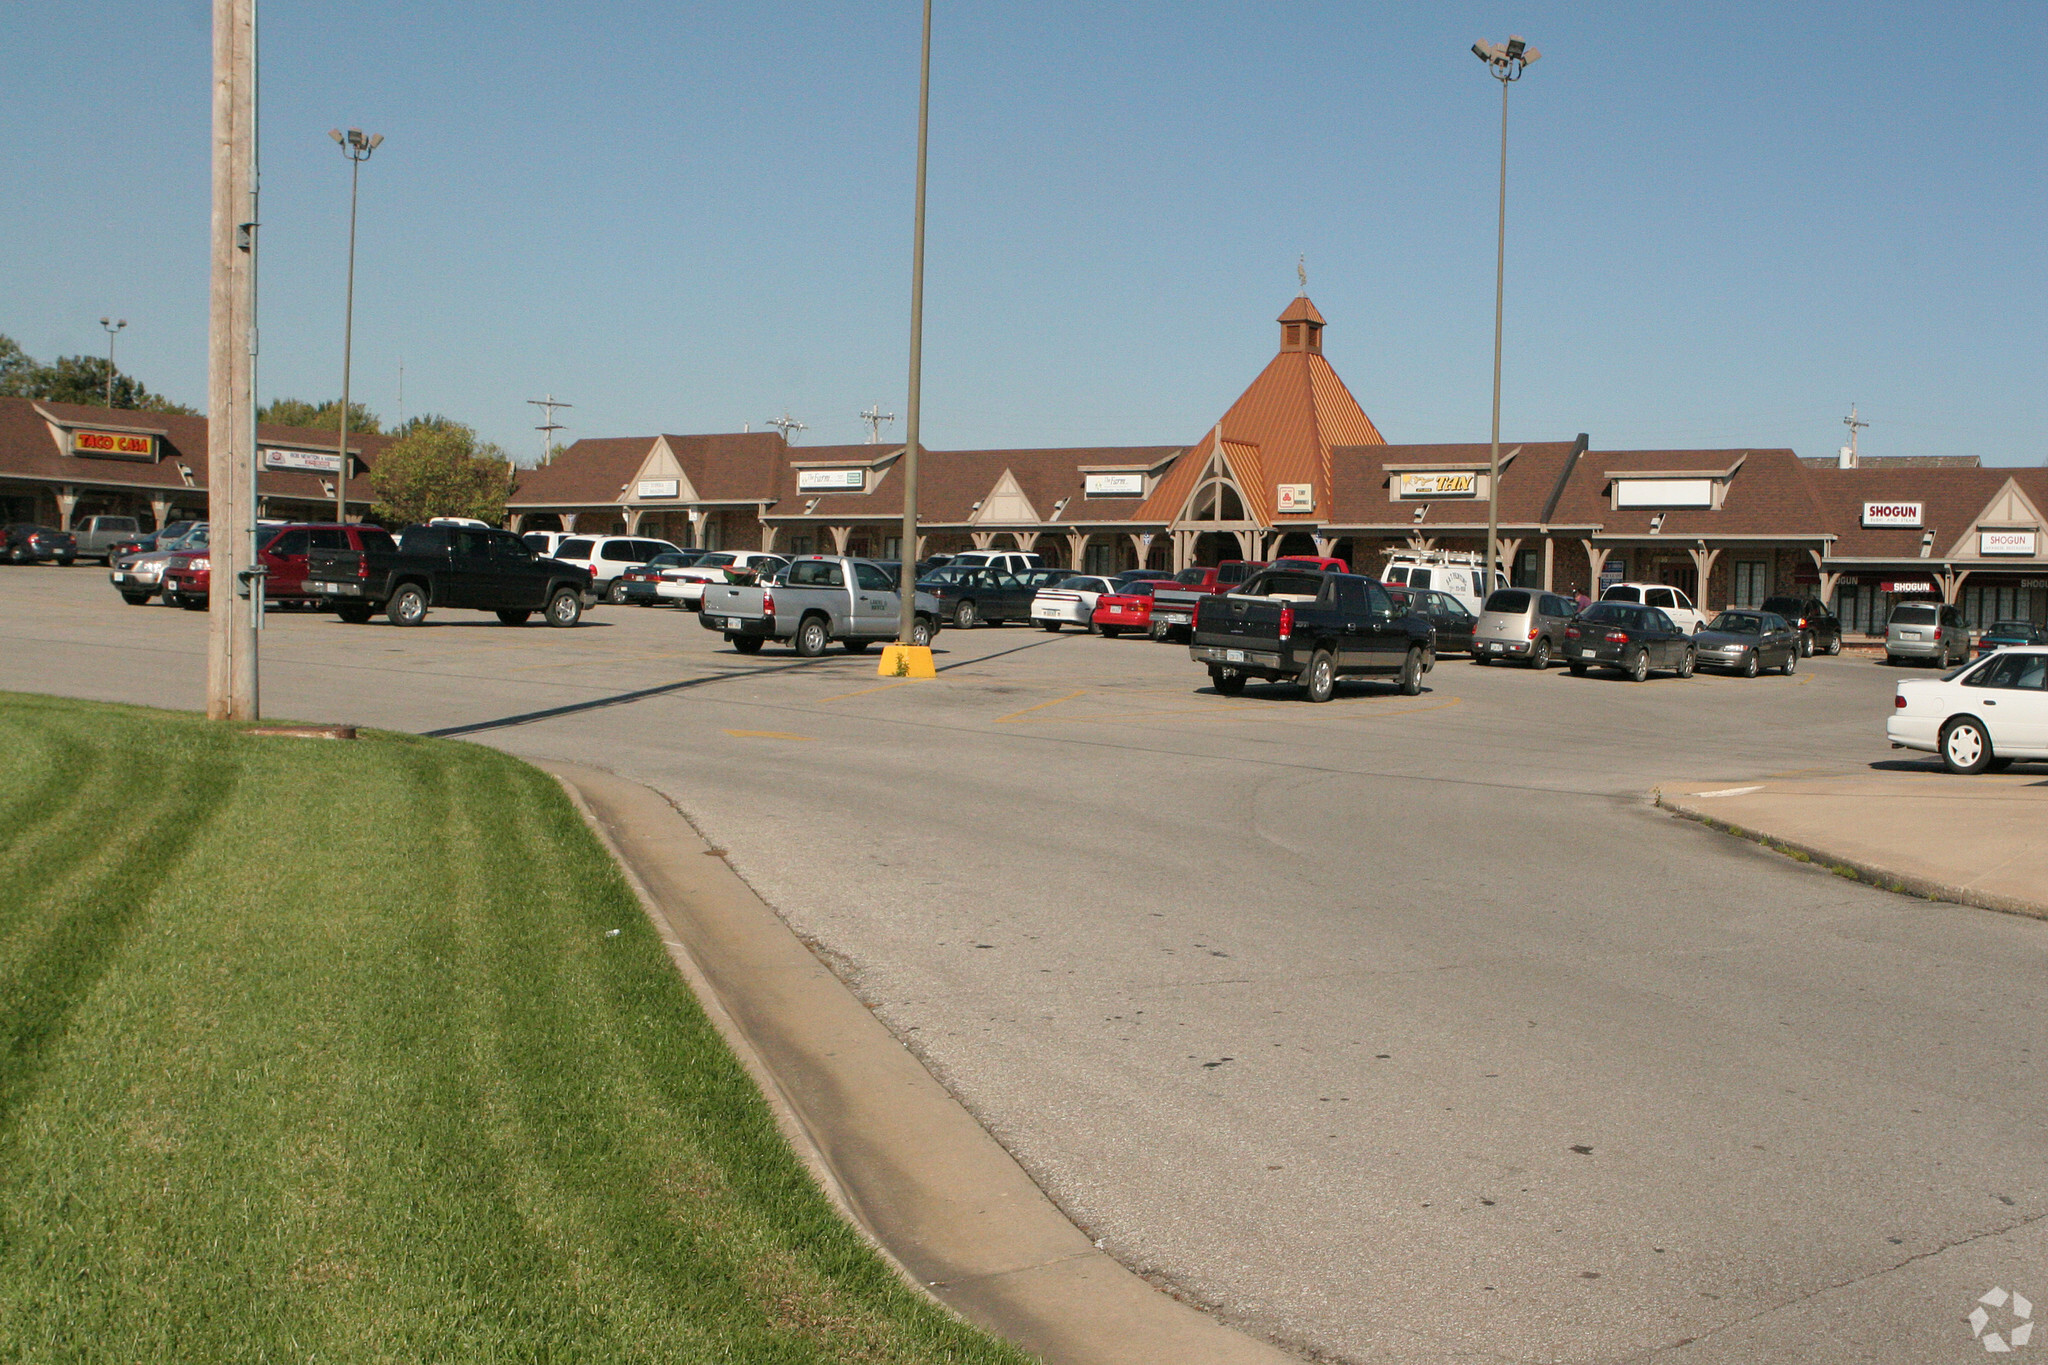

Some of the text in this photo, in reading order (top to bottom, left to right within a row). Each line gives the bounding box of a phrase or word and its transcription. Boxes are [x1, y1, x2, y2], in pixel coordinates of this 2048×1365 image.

[79, 433, 149, 453] TACO CASA
[1436, 475, 1474, 492] TAN
[1869, 505, 1917, 518] SHOGUN
[1990, 535, 2026, 545] SHOGUN
[1836, 576, 1859, 585] OGUN
[1893, 582, 1930, 592] SHOGUN
